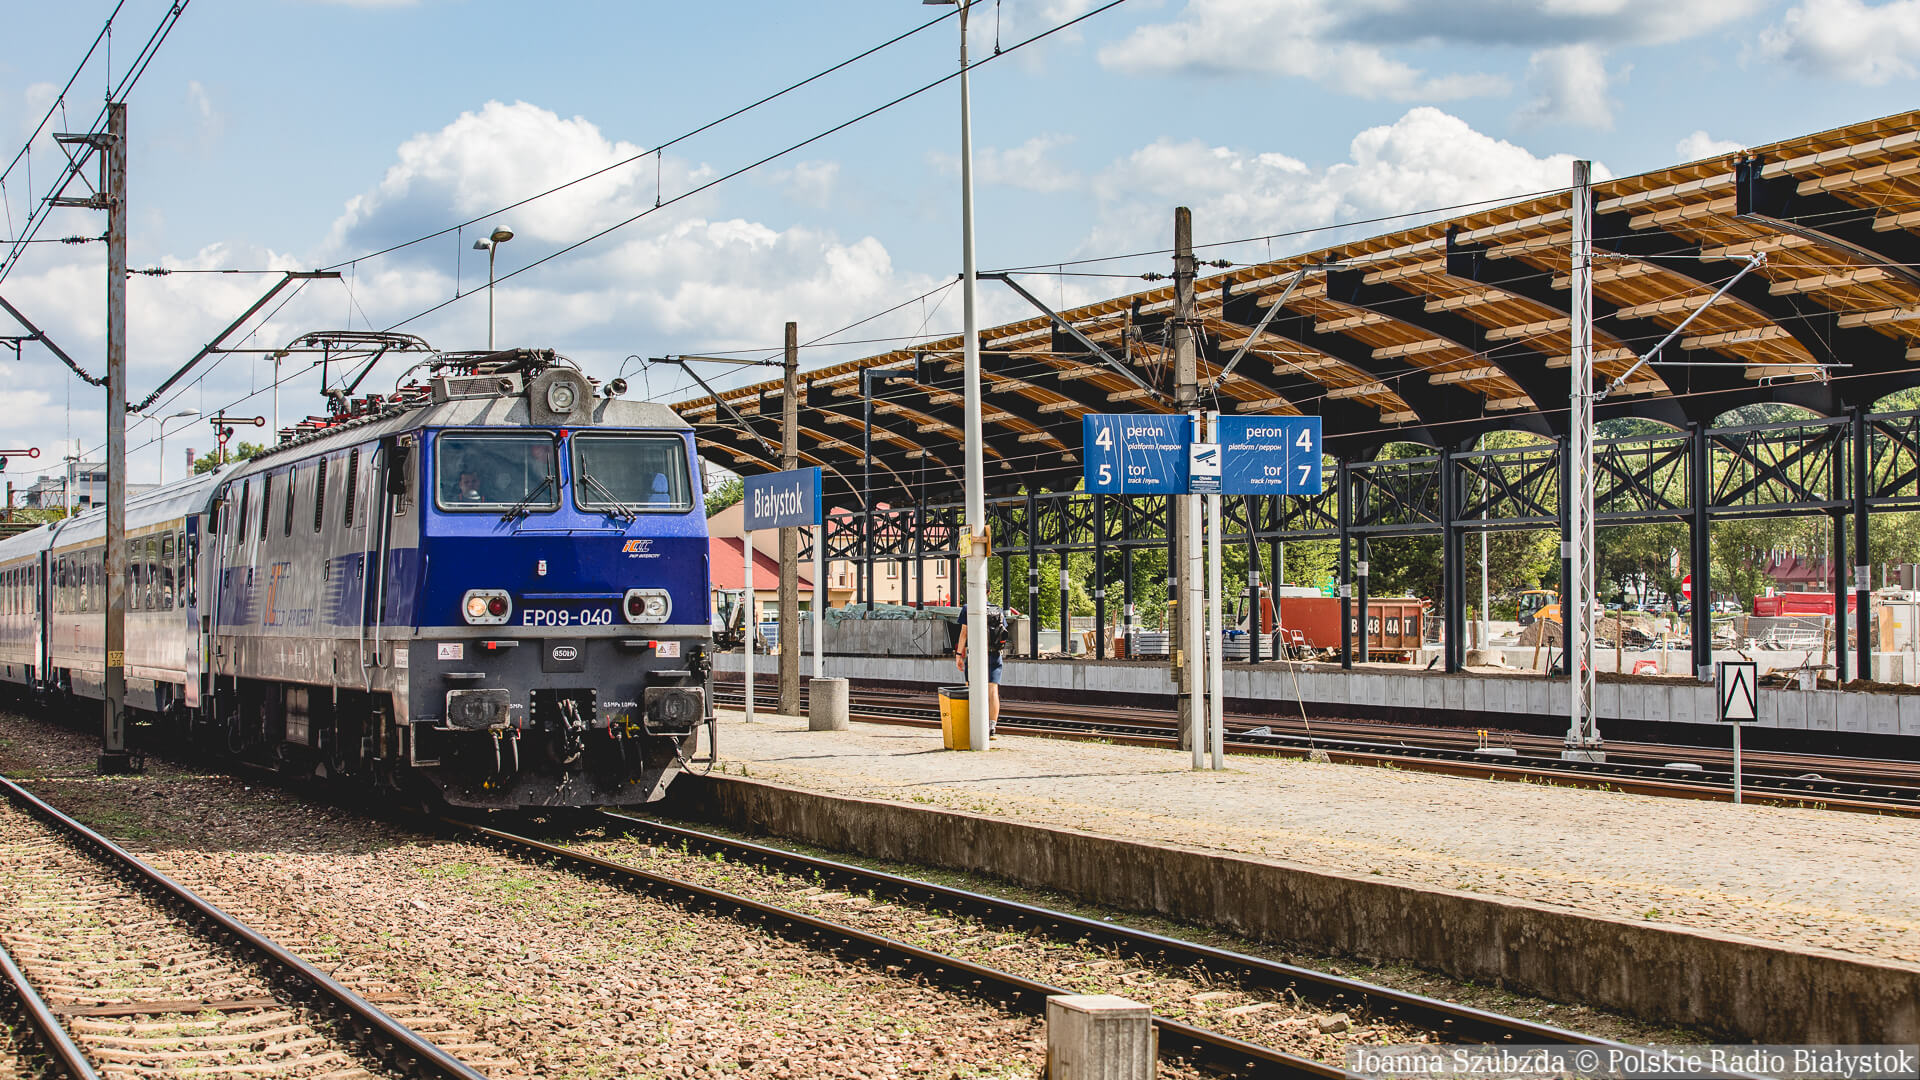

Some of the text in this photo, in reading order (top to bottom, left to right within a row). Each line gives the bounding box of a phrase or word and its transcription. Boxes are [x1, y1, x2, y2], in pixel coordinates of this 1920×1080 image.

[1095, 427, 1113, 451] 4
[1127, 427, 1163, 439] peron
[1246, 428, 1282, 440] peron
[1296, 428, 1313, 452] 4
[1098, 464, 1112, 486] 5
[1128, 465, 1146, 476] tor
[1264, 465, 1282, 476] tor
[1297, 465, 1312, 486] 7
[523, 609, 612, 626] EP09-040
